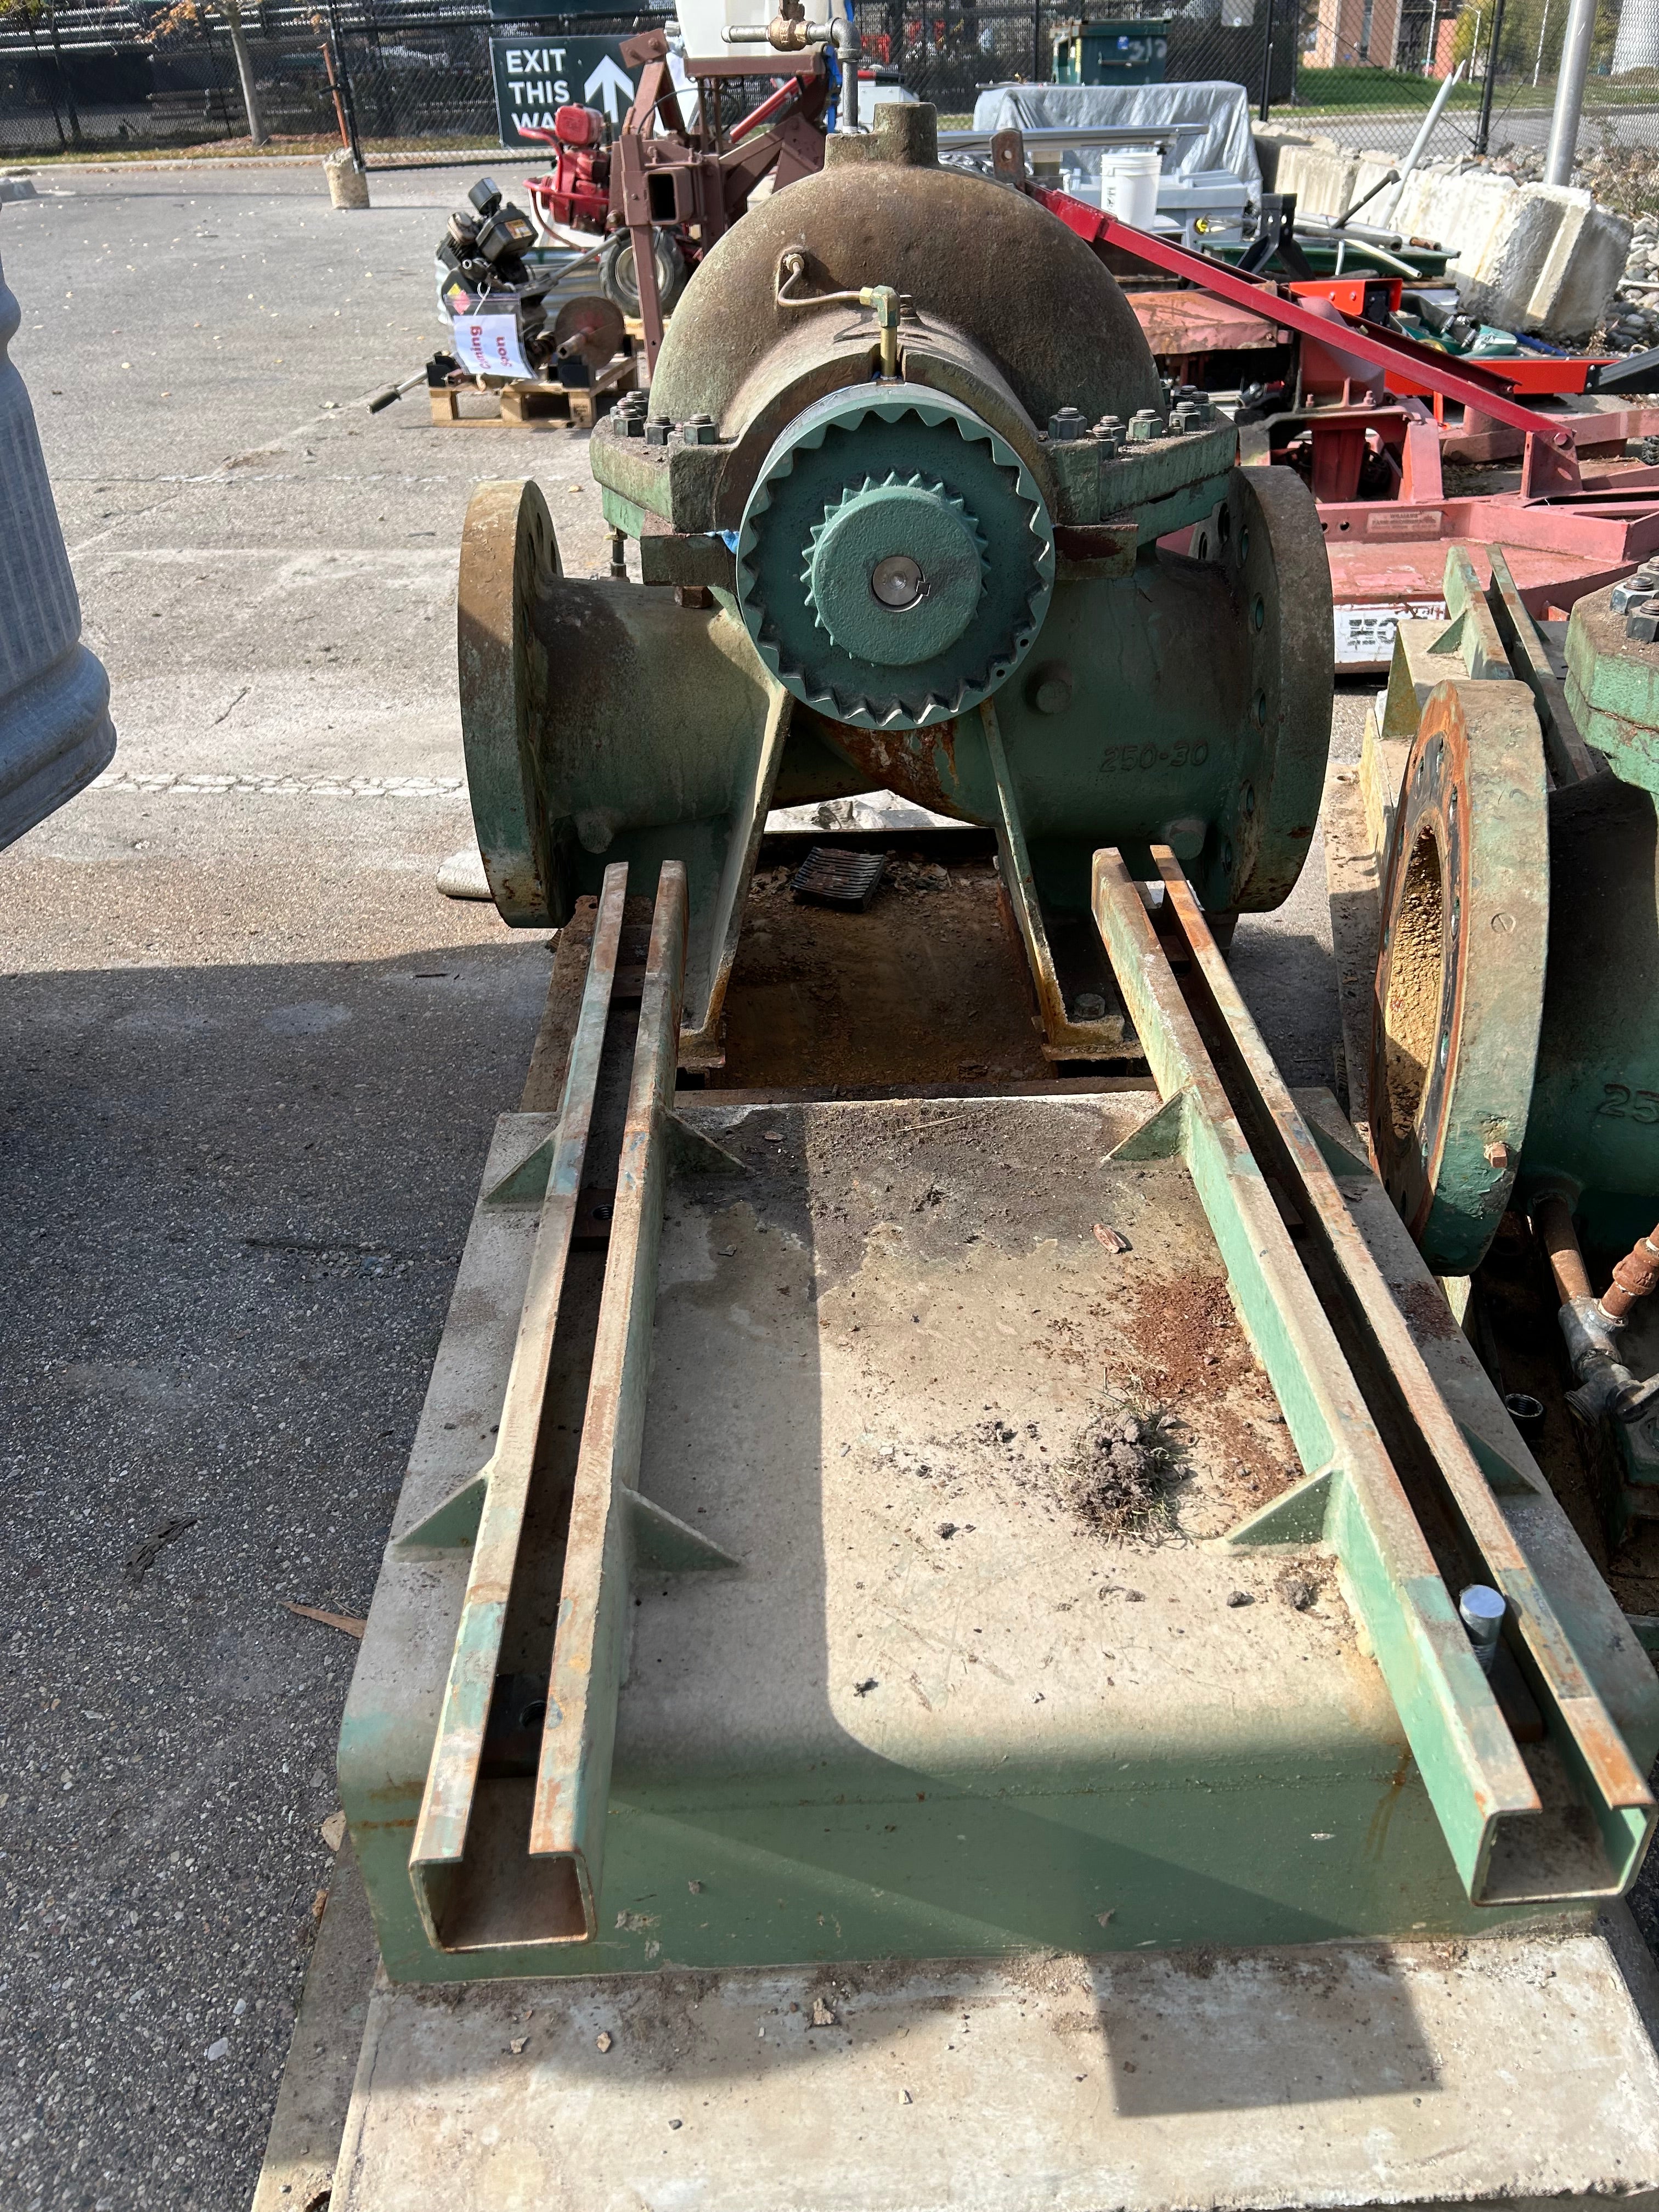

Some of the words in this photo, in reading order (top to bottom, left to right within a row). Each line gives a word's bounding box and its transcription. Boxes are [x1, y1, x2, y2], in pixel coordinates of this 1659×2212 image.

[506, 48, 566, 72] EXIT
[508, 80, 570, 104] THIS
[511, 112, 556, 132] WA
[1101, 740, 1209, 772] 250-30
